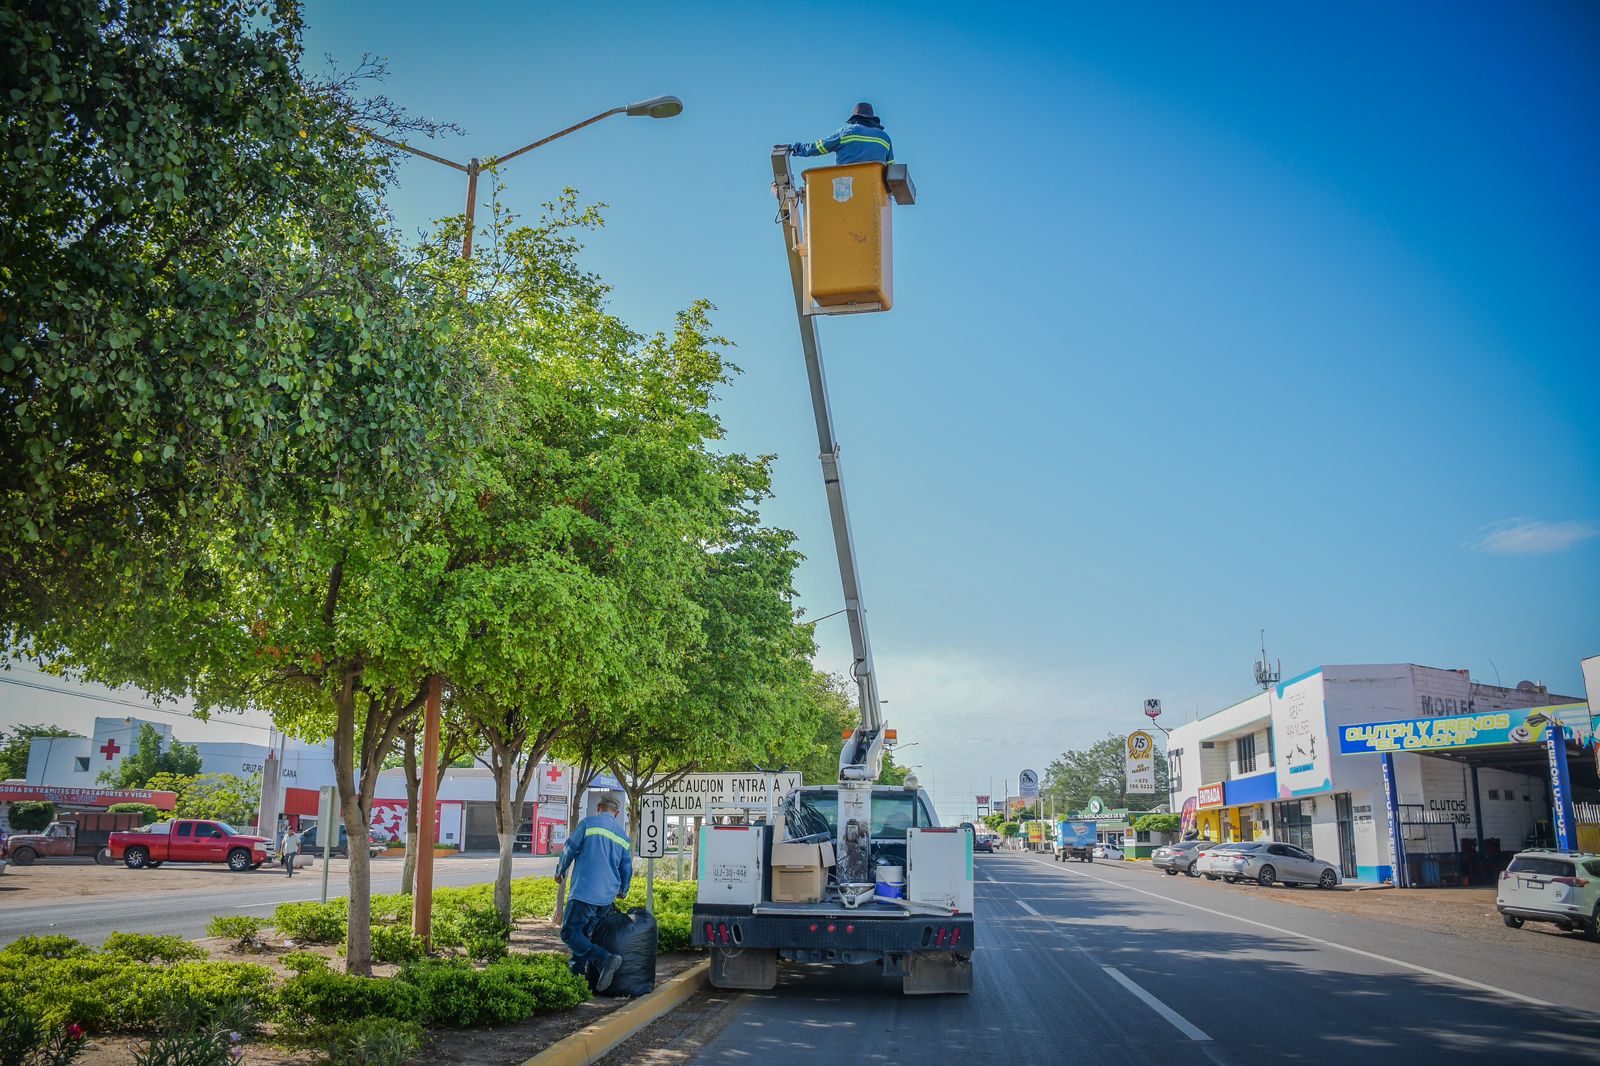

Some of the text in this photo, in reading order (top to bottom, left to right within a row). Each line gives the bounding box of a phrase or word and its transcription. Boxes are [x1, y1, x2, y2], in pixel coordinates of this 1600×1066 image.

[1345, 713, 1510, 742] CLUTCH Y FRENOS
[1134, 737, 1146, 748] 15
[1129, 748, 1150, 760] Ruta
[658, 779, 724, 792] PRECAUCION
[731, 778, 780, 793] ENTRAA
[1545, 729, 1566, 836] FRENOS CLUTCH
[36, 786, 70, 795] TRAMITES
[81, 788, 123, 798] PASAPORTE
[130, 791, 153, 799] VISAS
[1199, 786, 1220, 805] ENTRADA
[642, 798, 663, 808] Km
[663, 796, 702, 810] SALIDA
[1430, 799, 1466, 811] CLUTCHS
